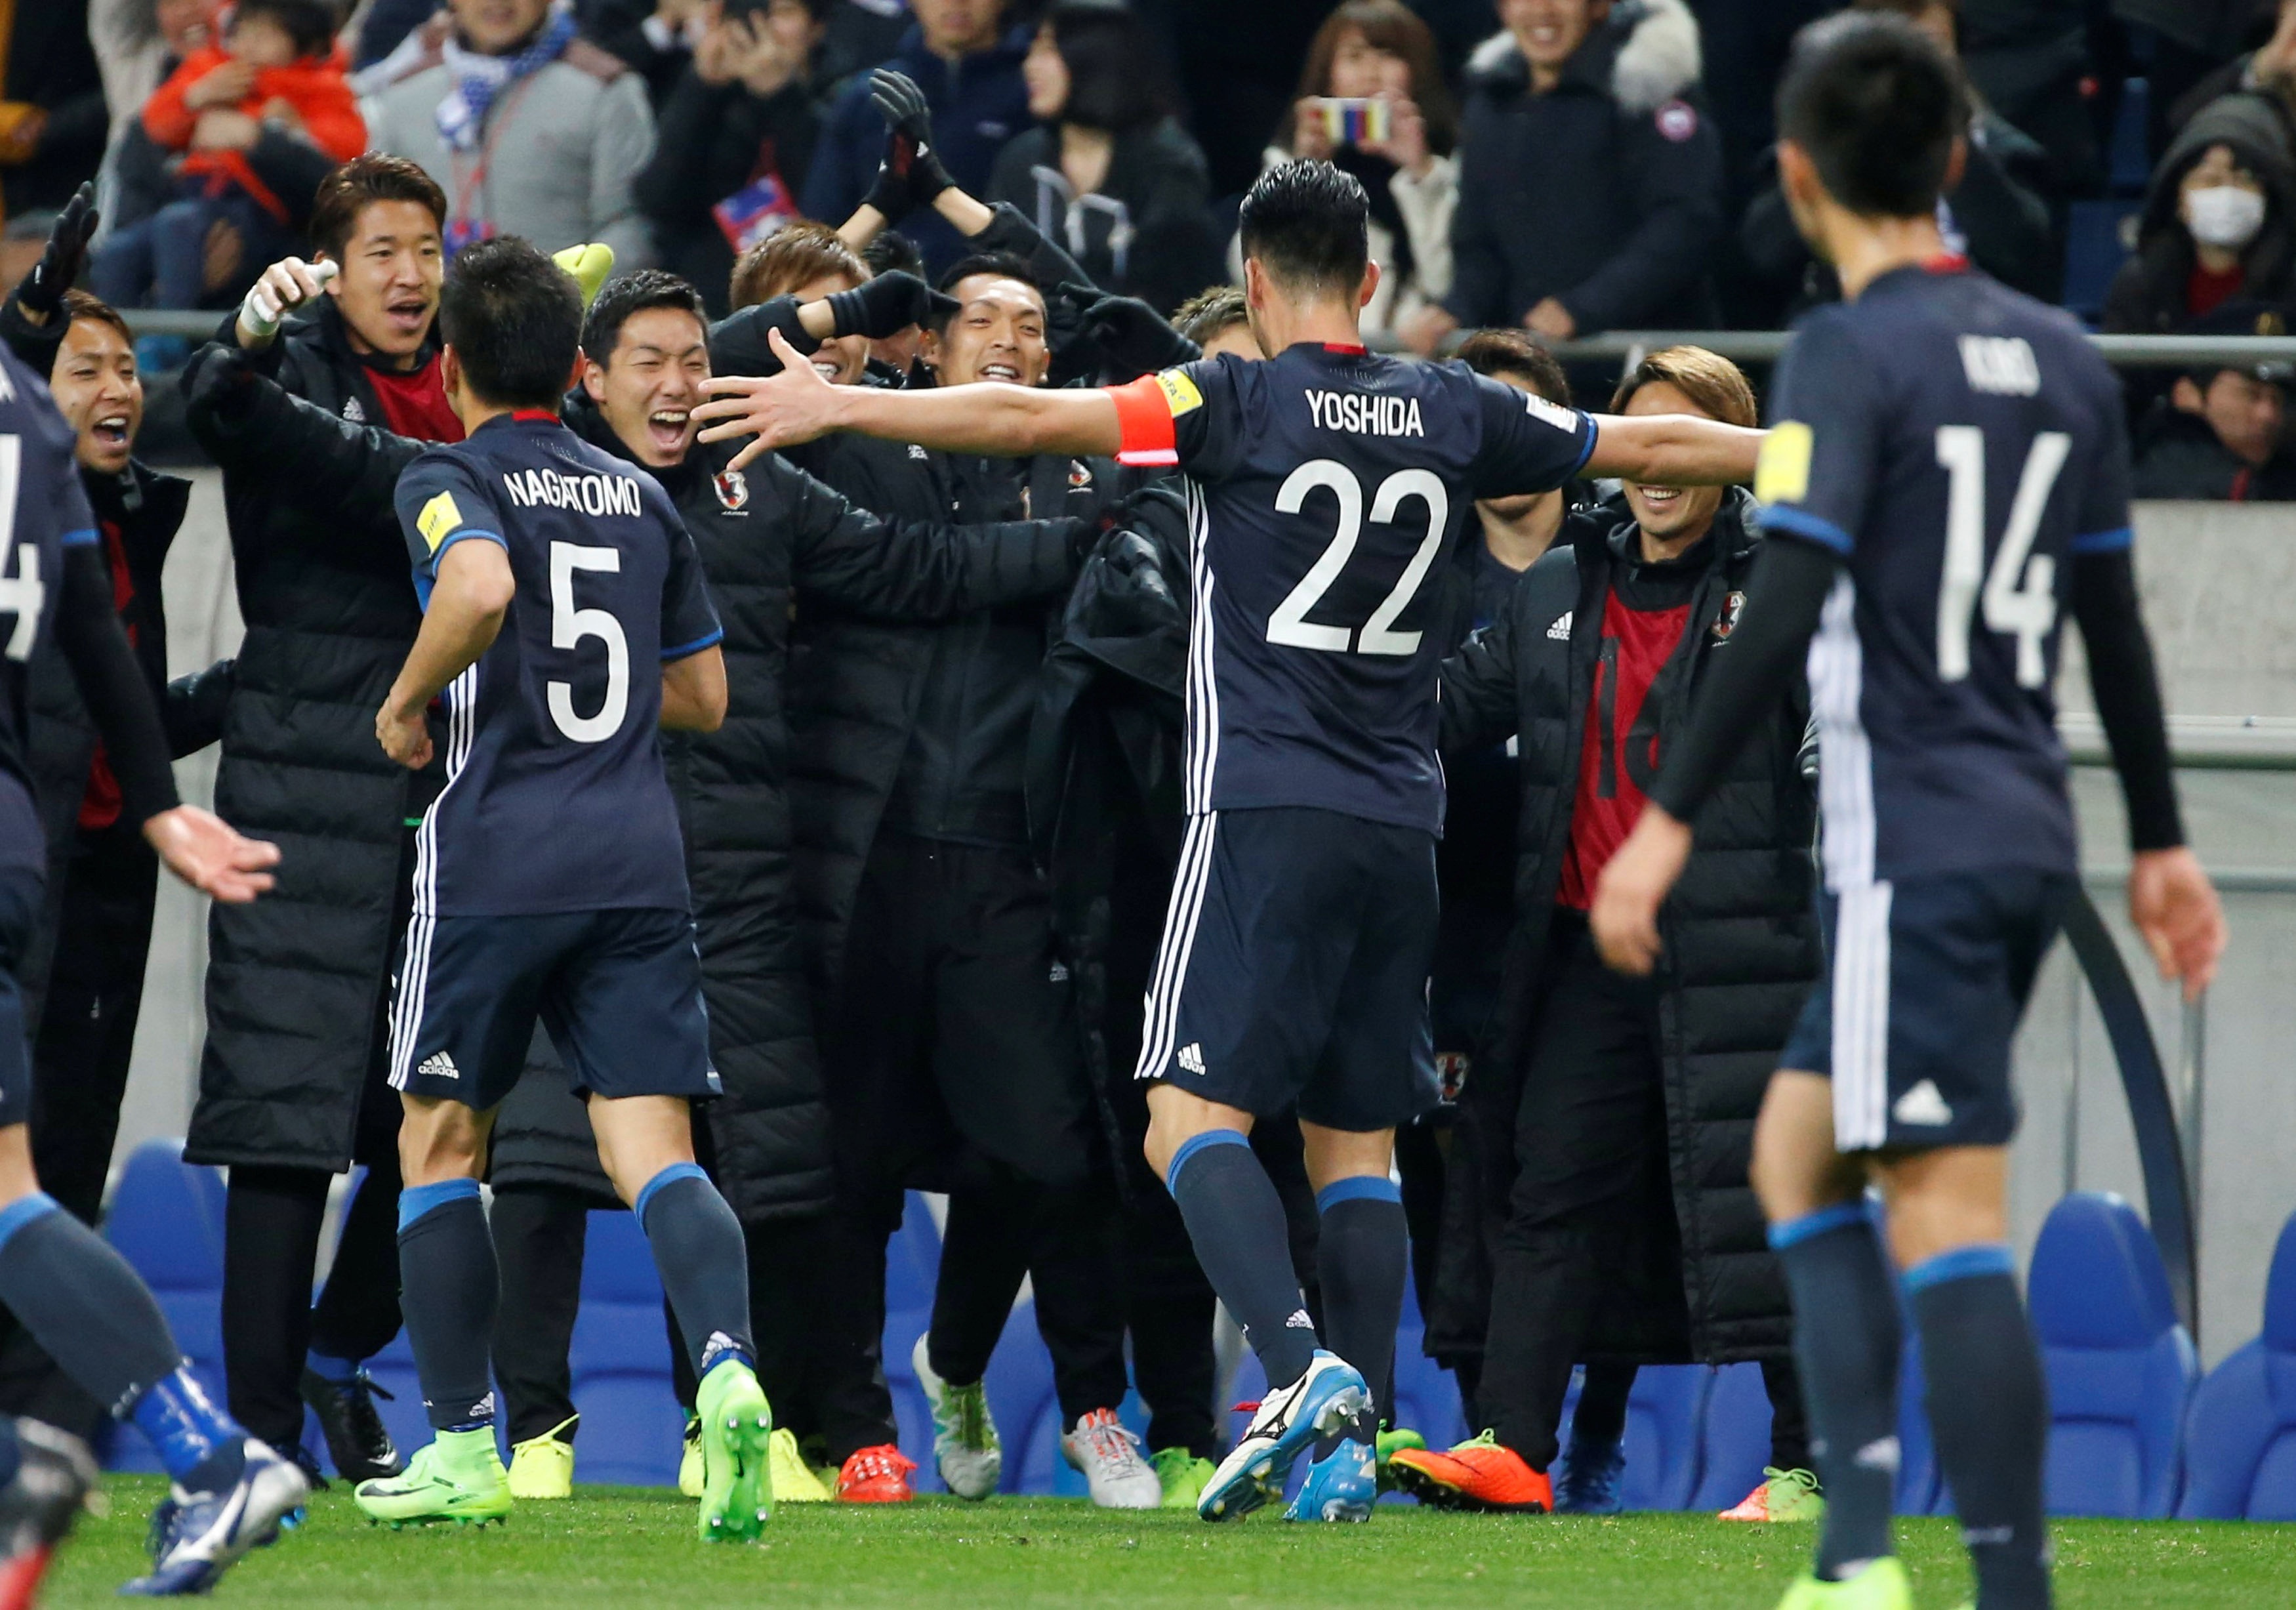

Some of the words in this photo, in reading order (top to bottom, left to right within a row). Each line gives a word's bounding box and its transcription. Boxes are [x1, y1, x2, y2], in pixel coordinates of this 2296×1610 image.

[1305, 389, 1424, 438] YOSHIDA
[503, 468, 642, 517] NAGATOMO
[1266, 459, 1448, 655] 22
[1935, 424, 2072, 690] 14
[547, 541, 629, 743] 5
[418, 1065, 459, 1079] adidas
